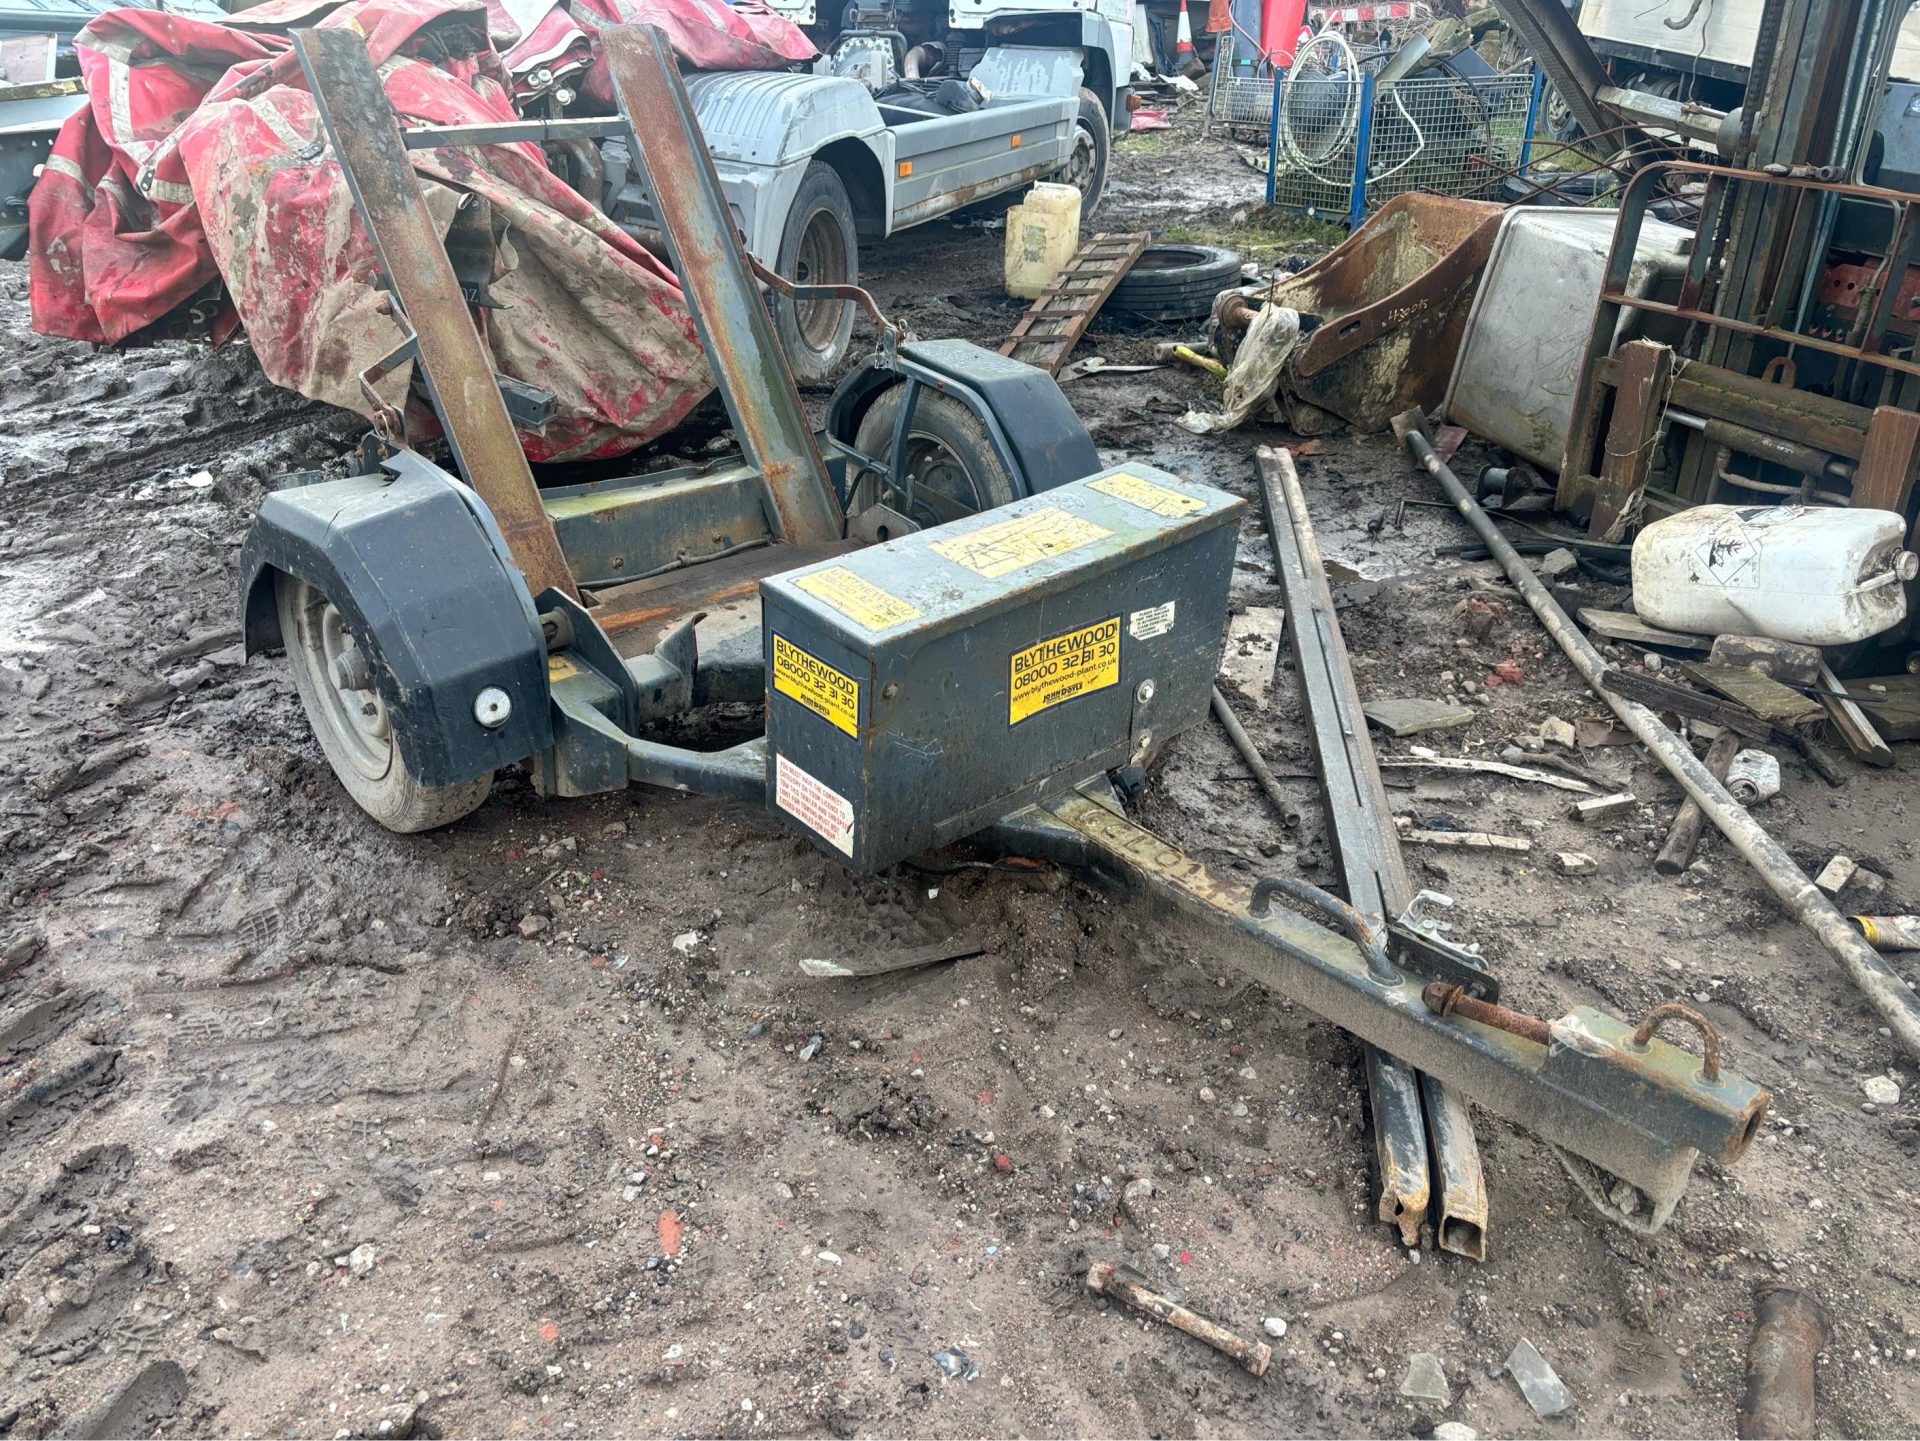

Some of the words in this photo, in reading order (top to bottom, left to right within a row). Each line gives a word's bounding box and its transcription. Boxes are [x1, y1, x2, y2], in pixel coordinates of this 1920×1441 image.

[776, 639, 855, 695] BLYTHEWOOD
[1014, 625, 1116, 672] BLYTHEWOOD
[1014, 662, 1058, 690] 08000
[1063, 654, 1079, 670] 32
[1083, 648, 1094, 664] 31
[1099, 642, 1116, 659] 30
[777, 655, 810, 682] 08000
[813, 677, 826, 692] 32
[829, 686, 838, 700] 31
[841, 693, 854, 710] 30
